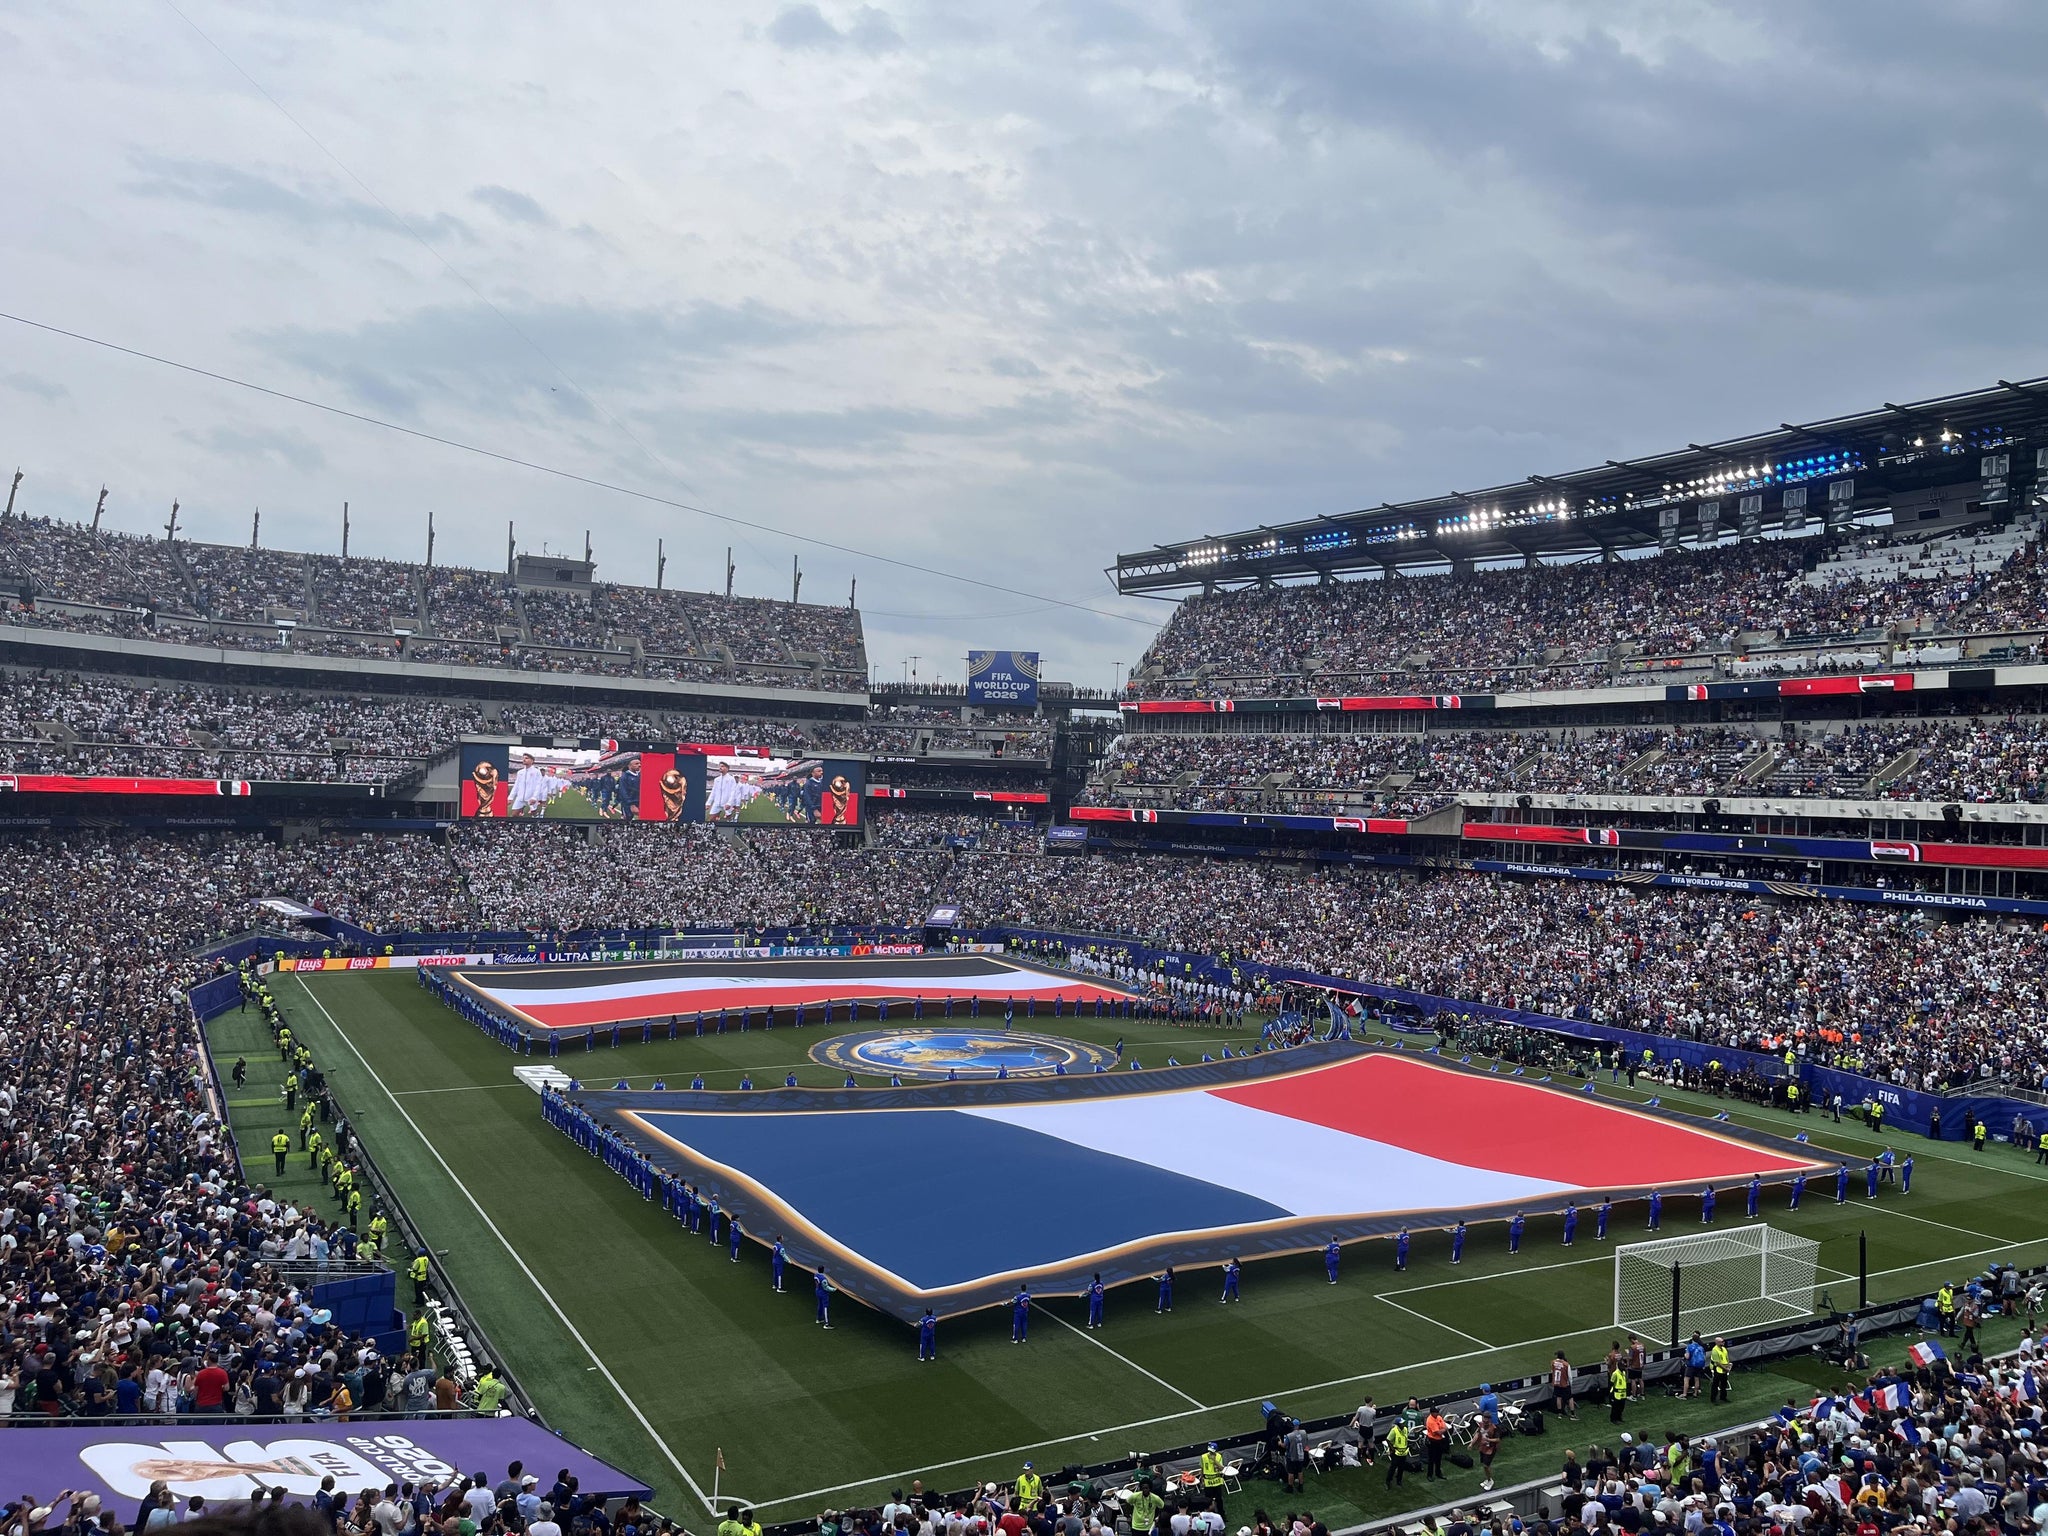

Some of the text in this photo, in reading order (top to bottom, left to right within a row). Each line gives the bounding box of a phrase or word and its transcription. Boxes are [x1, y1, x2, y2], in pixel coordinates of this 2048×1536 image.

[1983, 455, 2008, 478] 15
[1831, 480, 1853, 501] 70
[1784, 488, 1806, 509] 60
[1740, 496, 1760, 515] 44
[991, 672, 1013, 681] FIFA
[974, 681, 1031, 691] WORLD CUP
[983, 690, 1019, 700] 2026
[1171, 843, 1226, 852] PHILADELPHIA
[1507, 864, 1571, 875] PHILADELPHIA
[1671, 876, 1750, 889] FIFA WORLD CUP 2026
[1882, 892, 1987, 908] PHILADELPHIA
[350, 956, 374, 969] Lay's
[418, 954, 467, 968] verizon
[494, 952, 538, 965] Michelob
[548, 951, 590, 963] ULTRA
[1165, 955, 1181, 964] FIFA
[297, 957, 323, 971] Lay's
[1878, 1090, 1901, 1106] FIFA
[308, 1452, 362, 1478] FIFA
[346, 1436, 422, 1487] ORLD CUP
